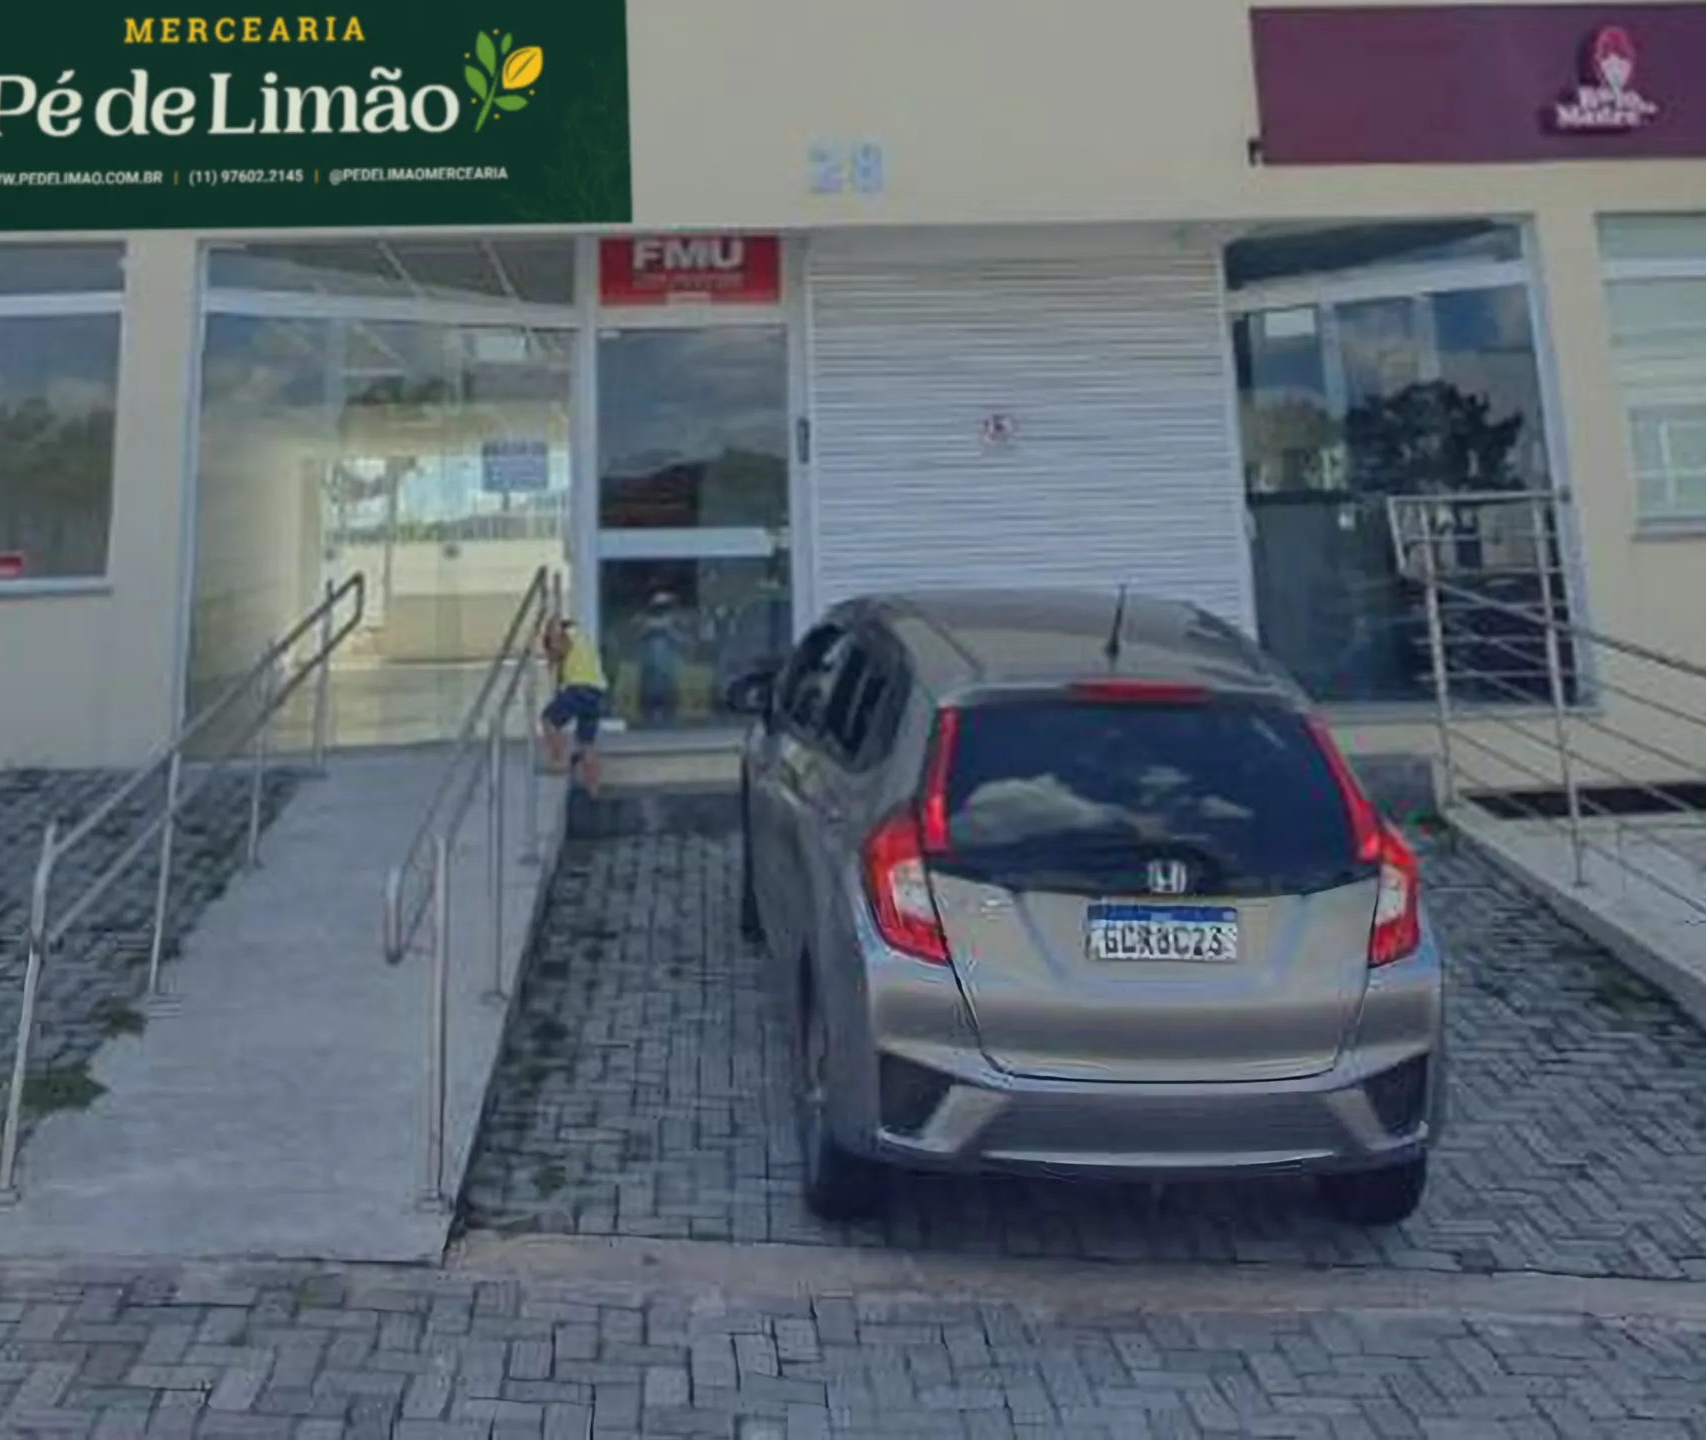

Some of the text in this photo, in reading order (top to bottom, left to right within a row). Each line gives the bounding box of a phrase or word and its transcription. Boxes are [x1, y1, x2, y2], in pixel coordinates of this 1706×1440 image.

[124, 15, 366, 44] MERCEARIA
[94, 68, 196, 138] de
[207, 66, 460, 136] Limão
[188, 169, 218, 186] (11)
[220, 168, 304, 184] 97602.2145
[329, 166, 509, 186] @PEDELIMAOMERCEARIA
[806, 140, 883, 195] 28
[632, 239, 745, 270] FMU
